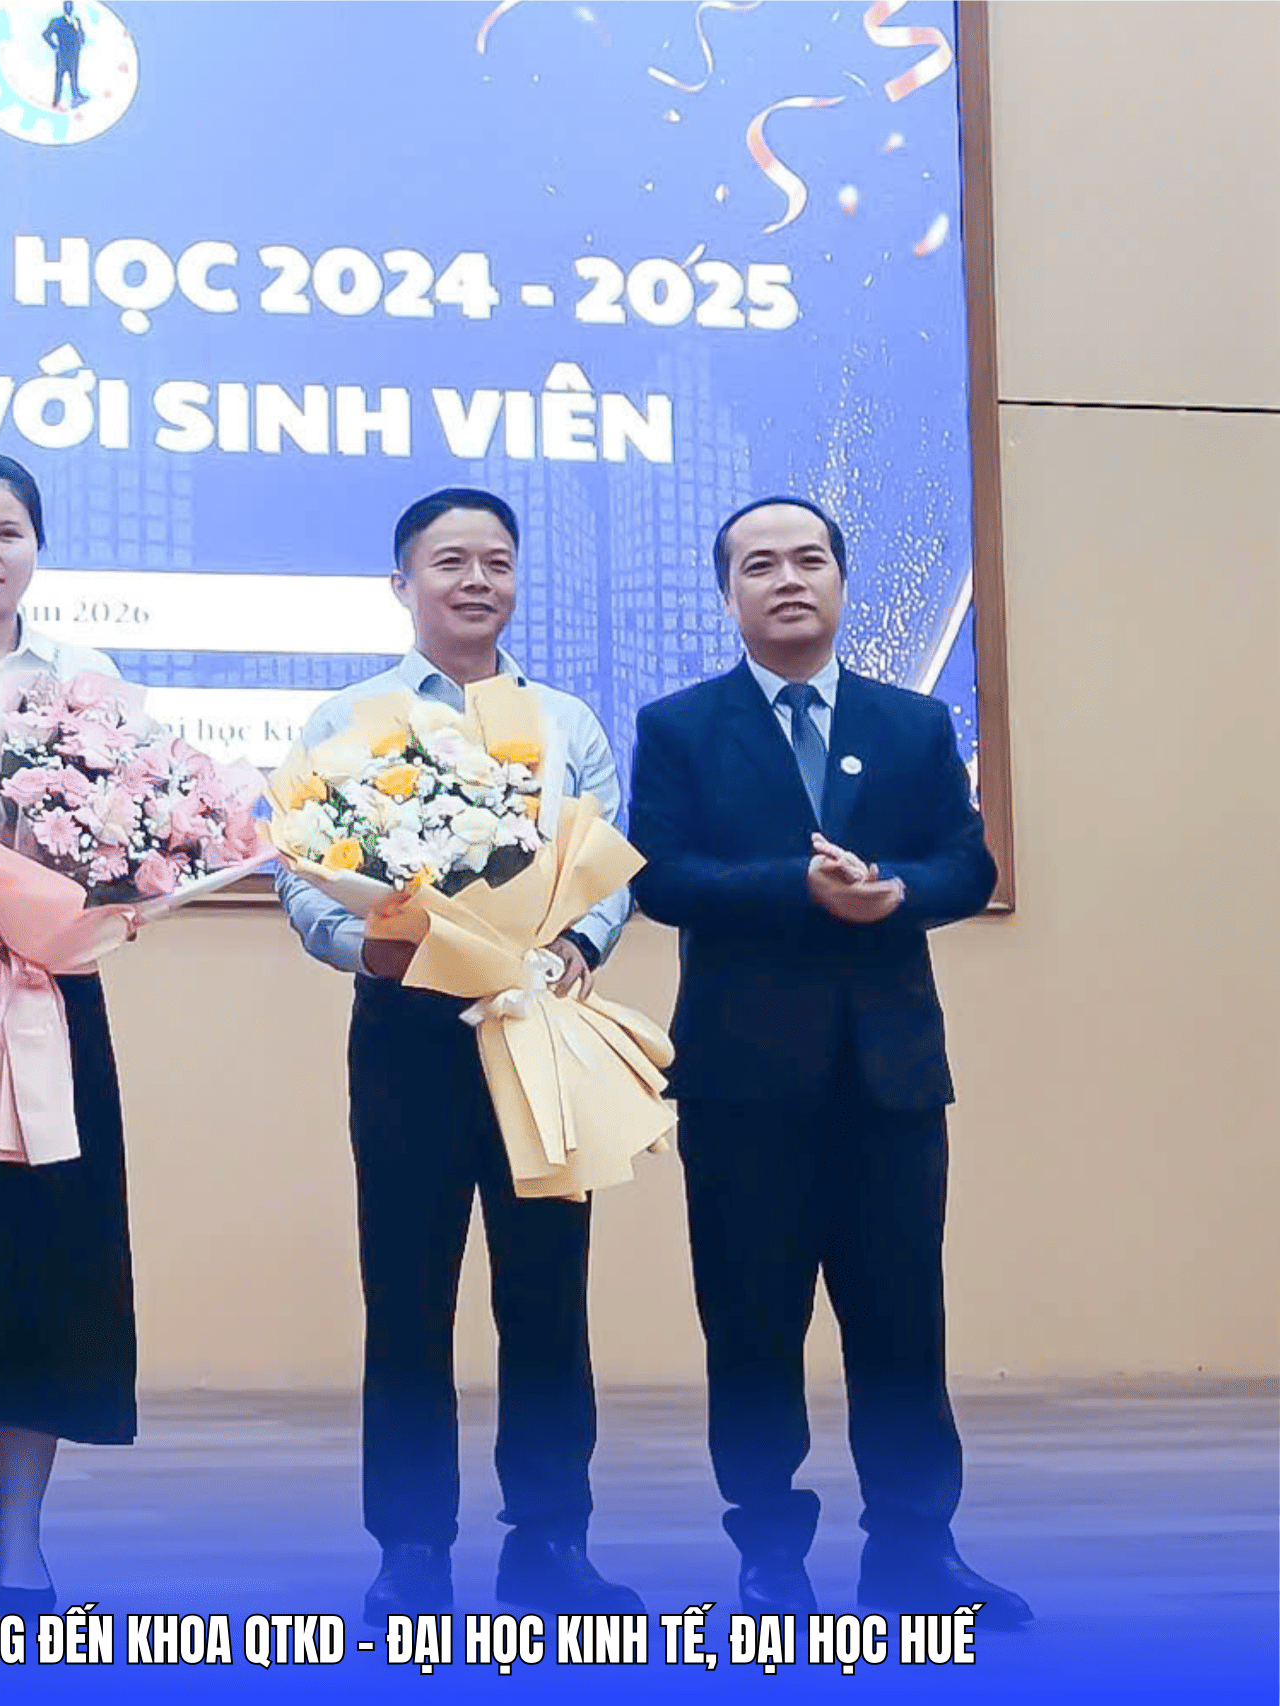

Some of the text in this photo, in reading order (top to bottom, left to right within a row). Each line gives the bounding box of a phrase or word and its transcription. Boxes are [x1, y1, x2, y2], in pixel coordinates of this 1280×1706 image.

[14, 234, 239, 335] HỌC
[258, 242, 501, 320] 2024
[520, 284, 556, 308] -
[574, 252, 801, 332] 2025
[153, 378, 412, 457] SINH
[431, 361, 674, 465] VIÊN
[73, 601, 150, 624] 2026
[198, 718, 251, 748] học
